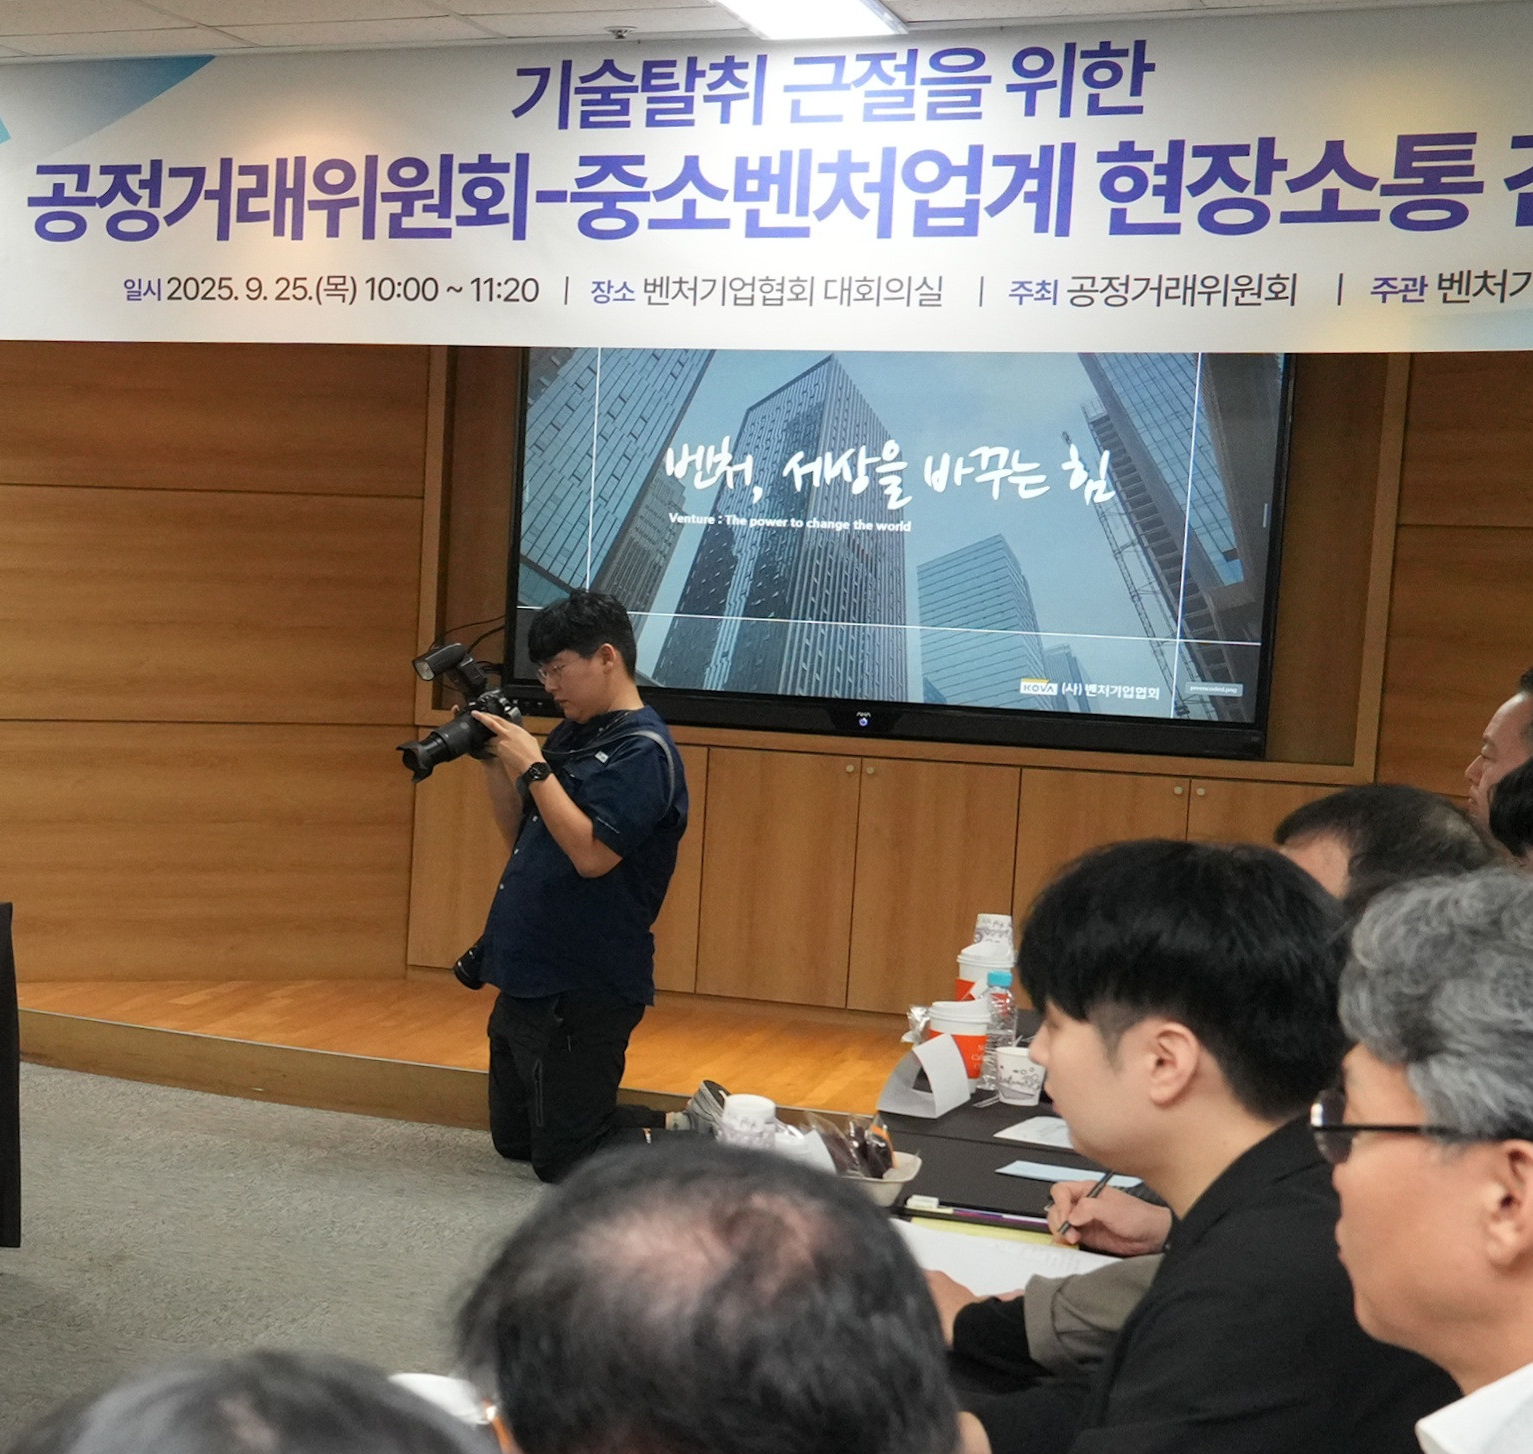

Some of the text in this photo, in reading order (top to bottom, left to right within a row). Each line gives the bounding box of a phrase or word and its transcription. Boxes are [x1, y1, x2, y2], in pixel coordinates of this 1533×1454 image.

[511, 40, 1156, 130] 기술탈취 근절을 위한
[27, 141, 1076, 243] 공정거래위원회-중소벤처업계
[1097, 132, 1485, 236] 현장소통
[123, 277, 162, 302] 일시
[166, 276, 239, 301] 2025.
[245, 276, 268, 301] 9.
[274, 275, 357, 306] 25.(목)
[365, 276, 439, 302] 10:00
[470, 277, 540, 303] 11:20
[590, 275, 944, 308] 장소 벤처기업협회 대회의실
[1008, 272, 1298, 308] 주최 공정거래위원회
[1370, 275, 1429, 304] 주관
[665, 435, 1116, 511] 벤처, 세상을 바꾸는 힘
[668, 512, 715, 525] Venture
[725, 515, 747, 526] The
[749, 517, 787, 529] power
[790, 518, 804, 528] to
[806, 519, 850, 531] change
[853, 519, 873, 531] the
[876, 520, 912, 533] world
[1023, 682, 1160, 700] KOVA (사) 벤처기업협회
